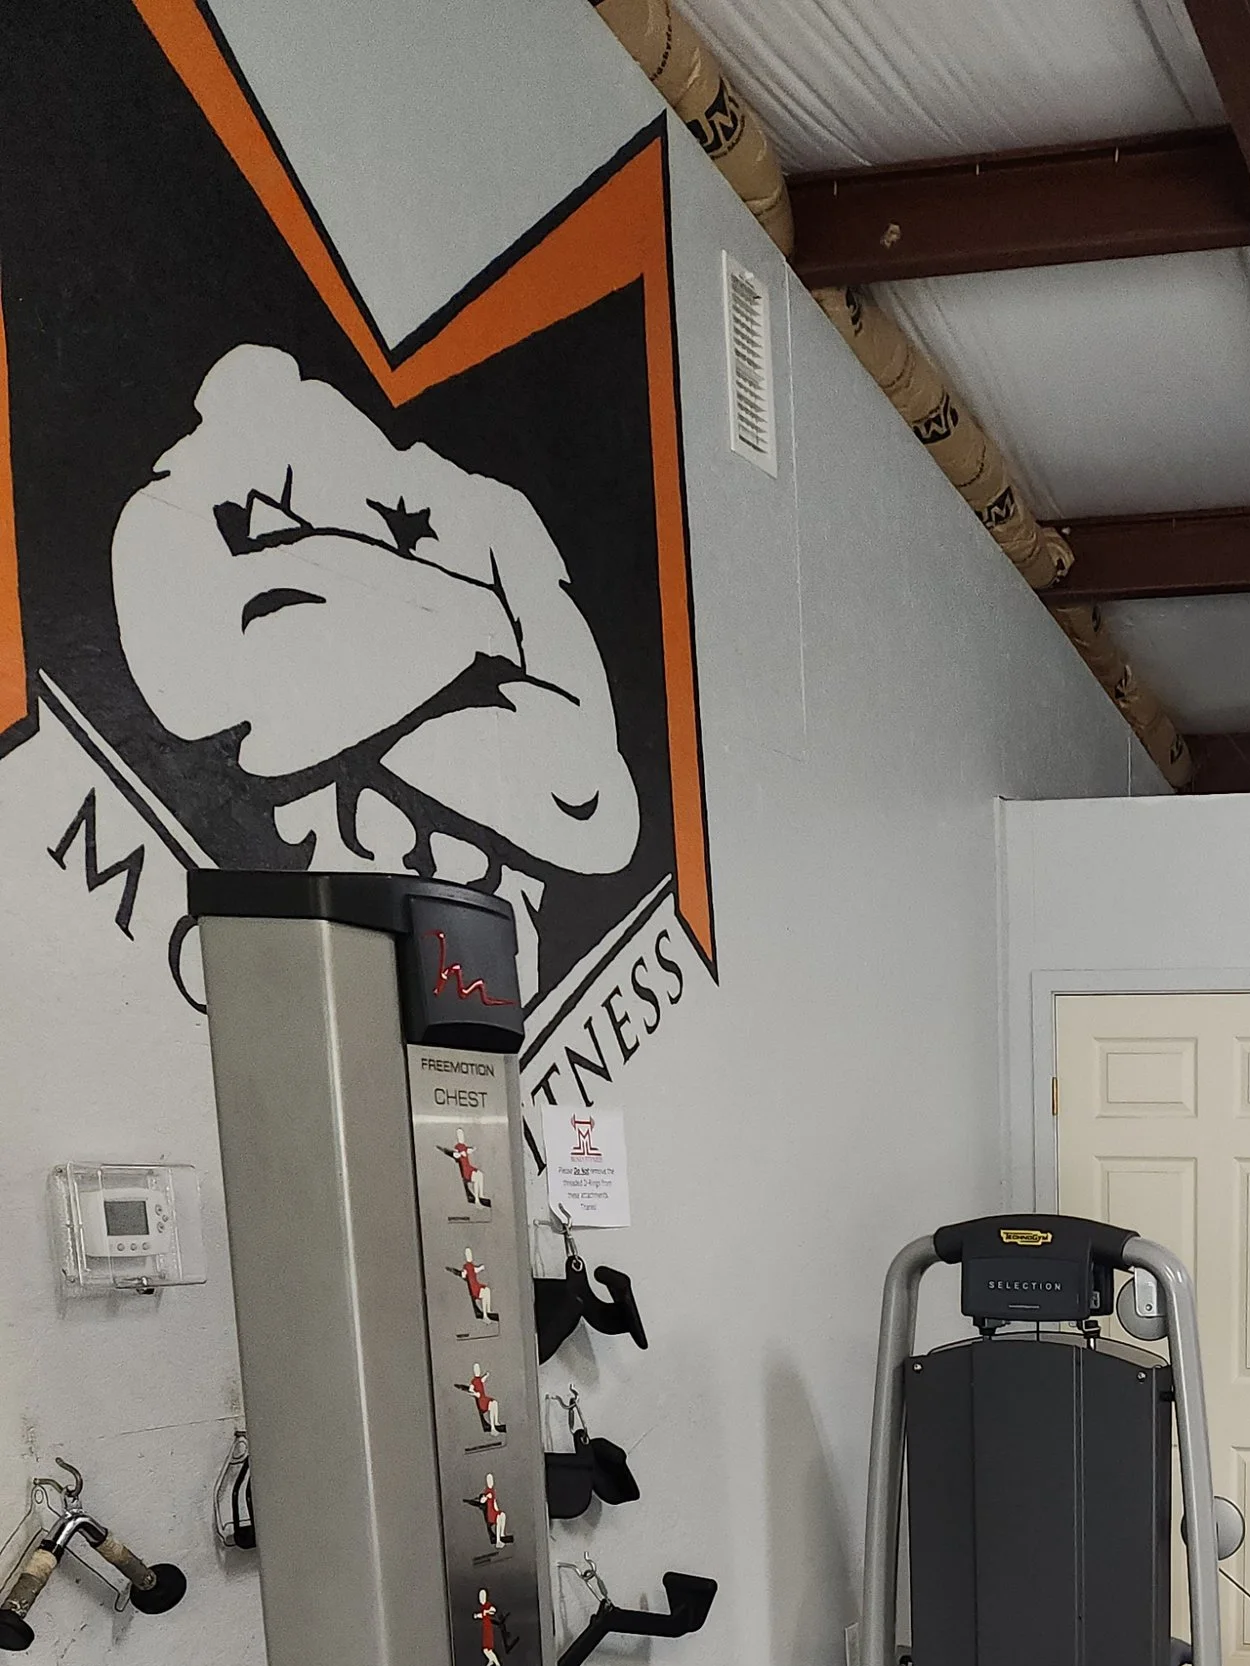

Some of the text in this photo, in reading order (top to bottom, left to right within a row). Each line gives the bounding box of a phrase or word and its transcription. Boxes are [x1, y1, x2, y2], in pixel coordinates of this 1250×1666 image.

[520, 927, 687, 1178] ITNESS
[420, 1057, 495, 1078] FREEMOTION
[433, 1087, 488, 1109] CHEST
[988, 1281, 1062, 1291] SELECTION
